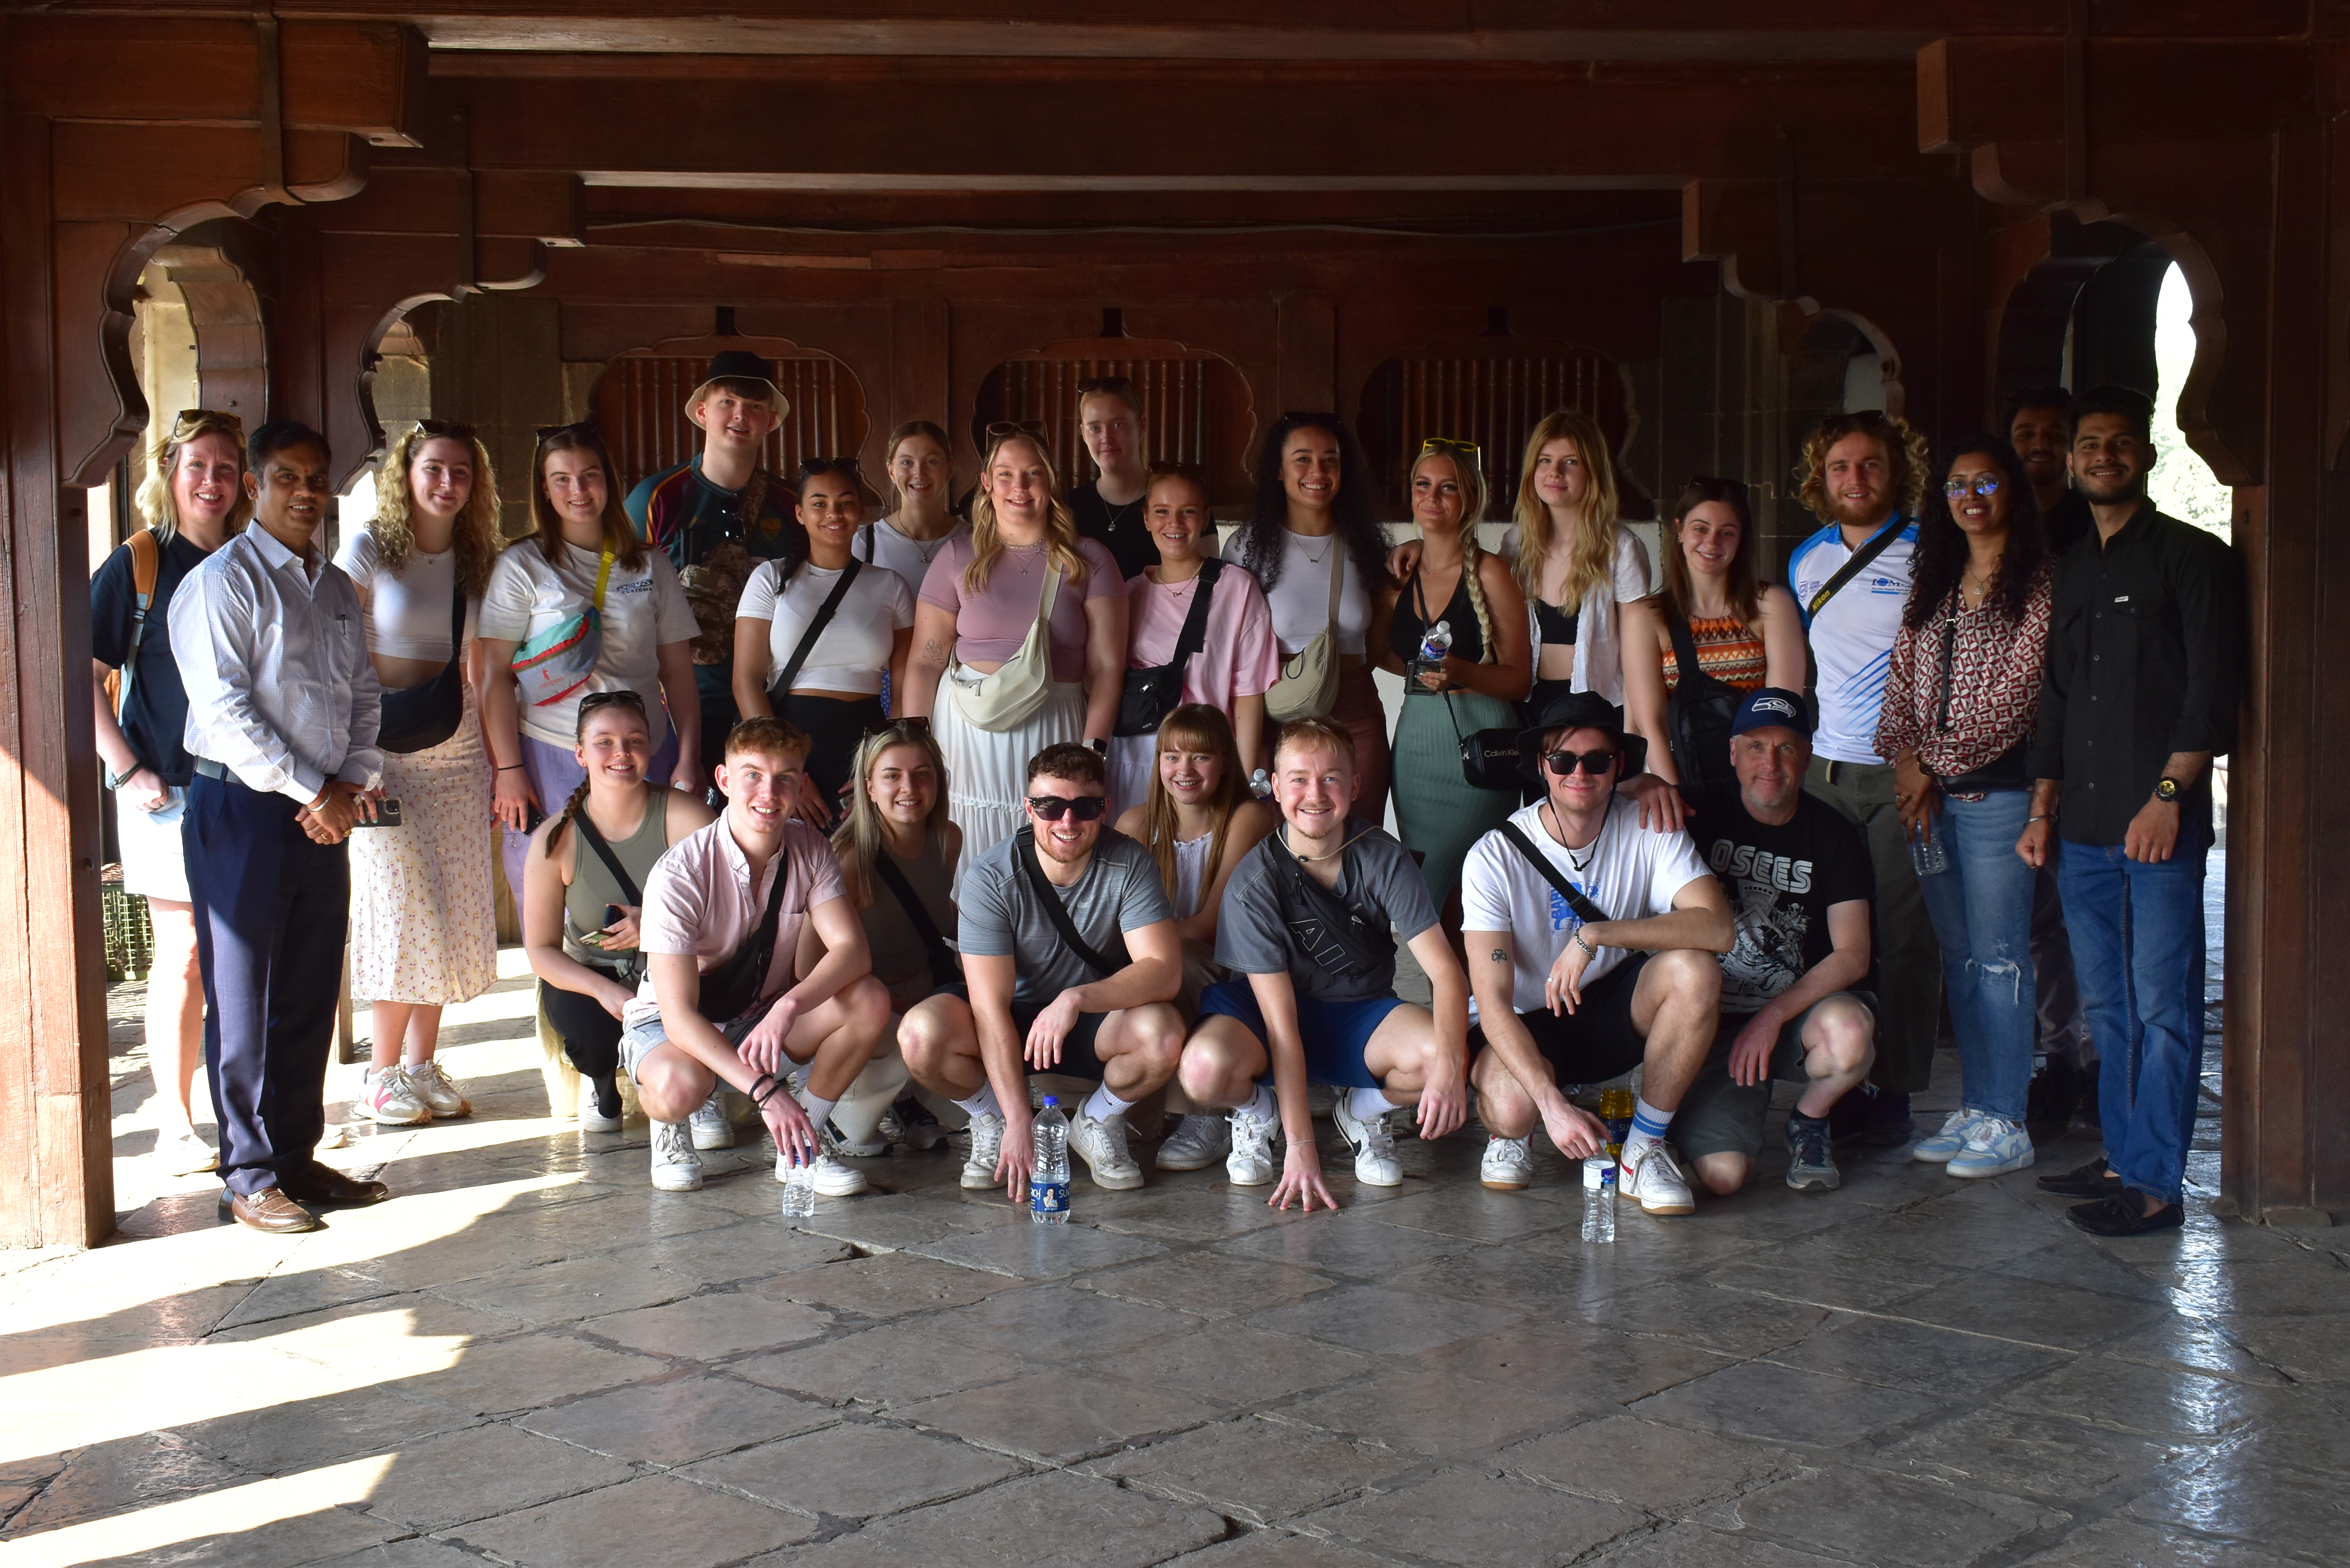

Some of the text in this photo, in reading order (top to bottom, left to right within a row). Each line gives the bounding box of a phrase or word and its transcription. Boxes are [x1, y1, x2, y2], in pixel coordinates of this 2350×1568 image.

[1812, 590, 1830, 612] Nikon
[539, 677, 563, 689] cotopaxi
[1484, 749, 1507, 757] Calvin
[1710, 838, 1813, 894] OSEES
[1288, 918, 1354, 974] AI
